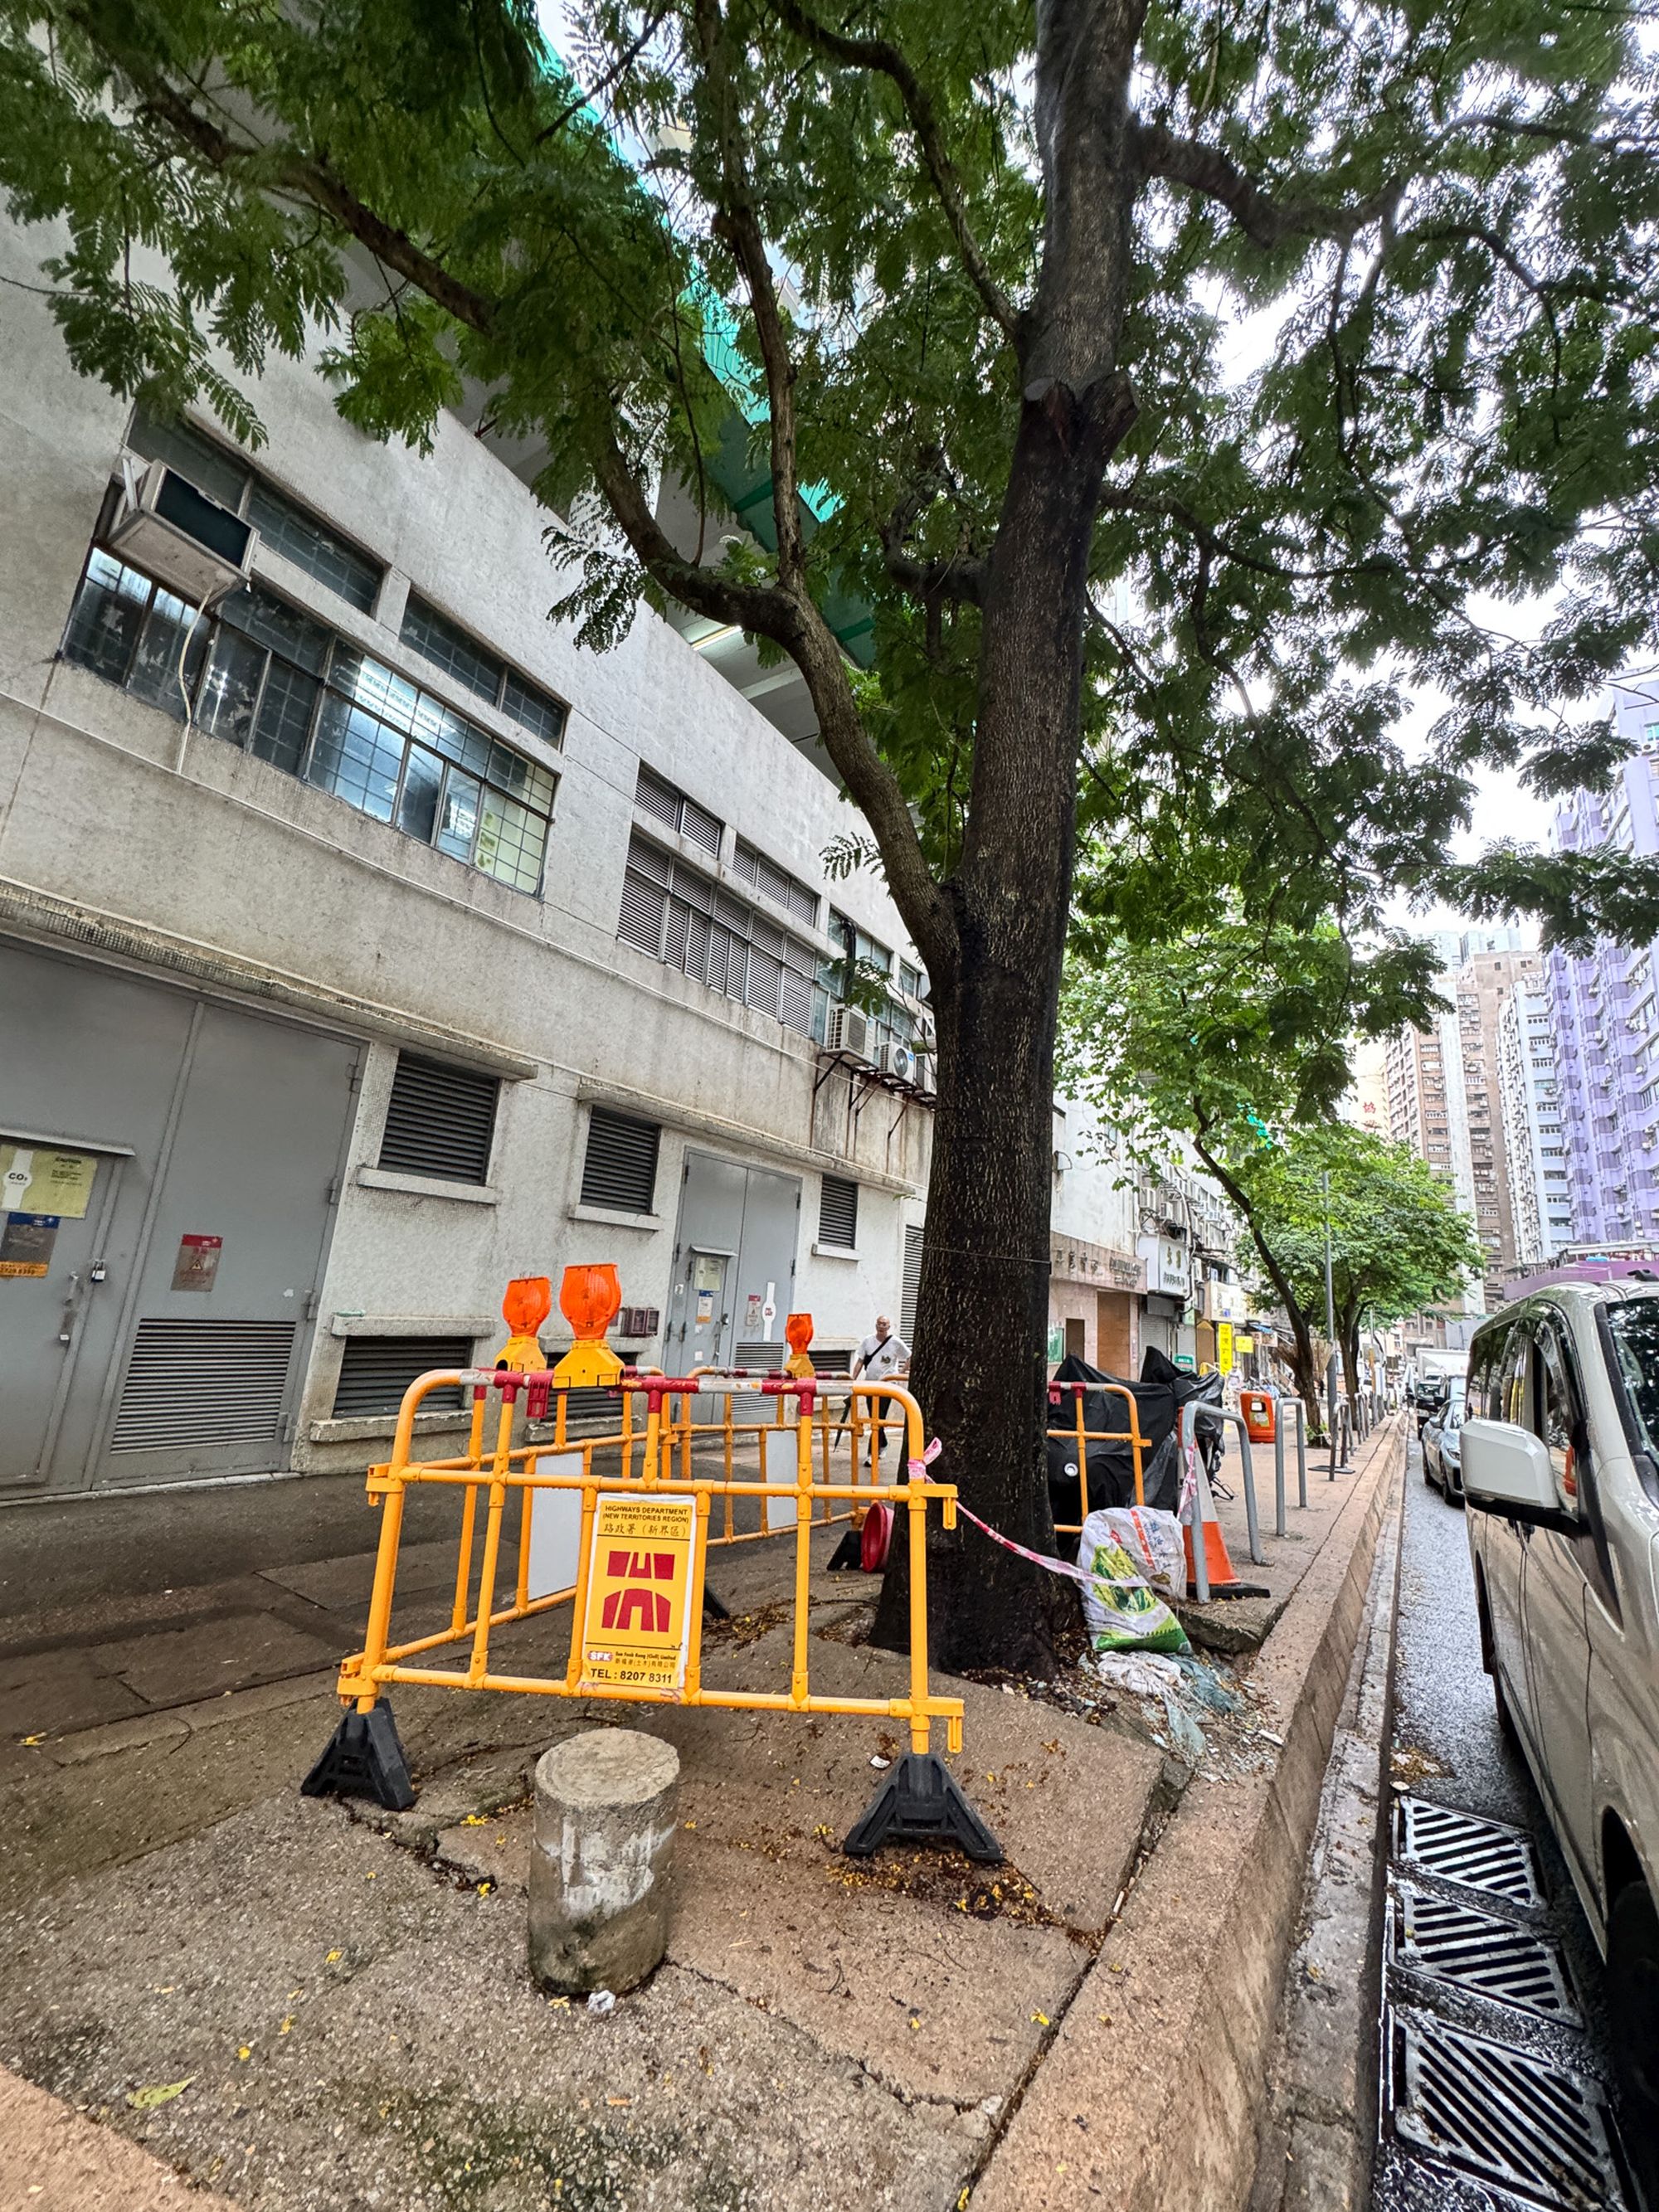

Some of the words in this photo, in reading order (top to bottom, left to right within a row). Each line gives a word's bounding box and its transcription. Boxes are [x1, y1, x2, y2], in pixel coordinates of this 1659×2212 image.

[642, 1507, 688, 1515] DEPARTMENT
[663, 1516, 689, 1524] REGION)
[589, 1651, 611, 1661] SFK
[620, 1670, 646, 1681] 8207
[649, 1673, 672, 1684] 8311
